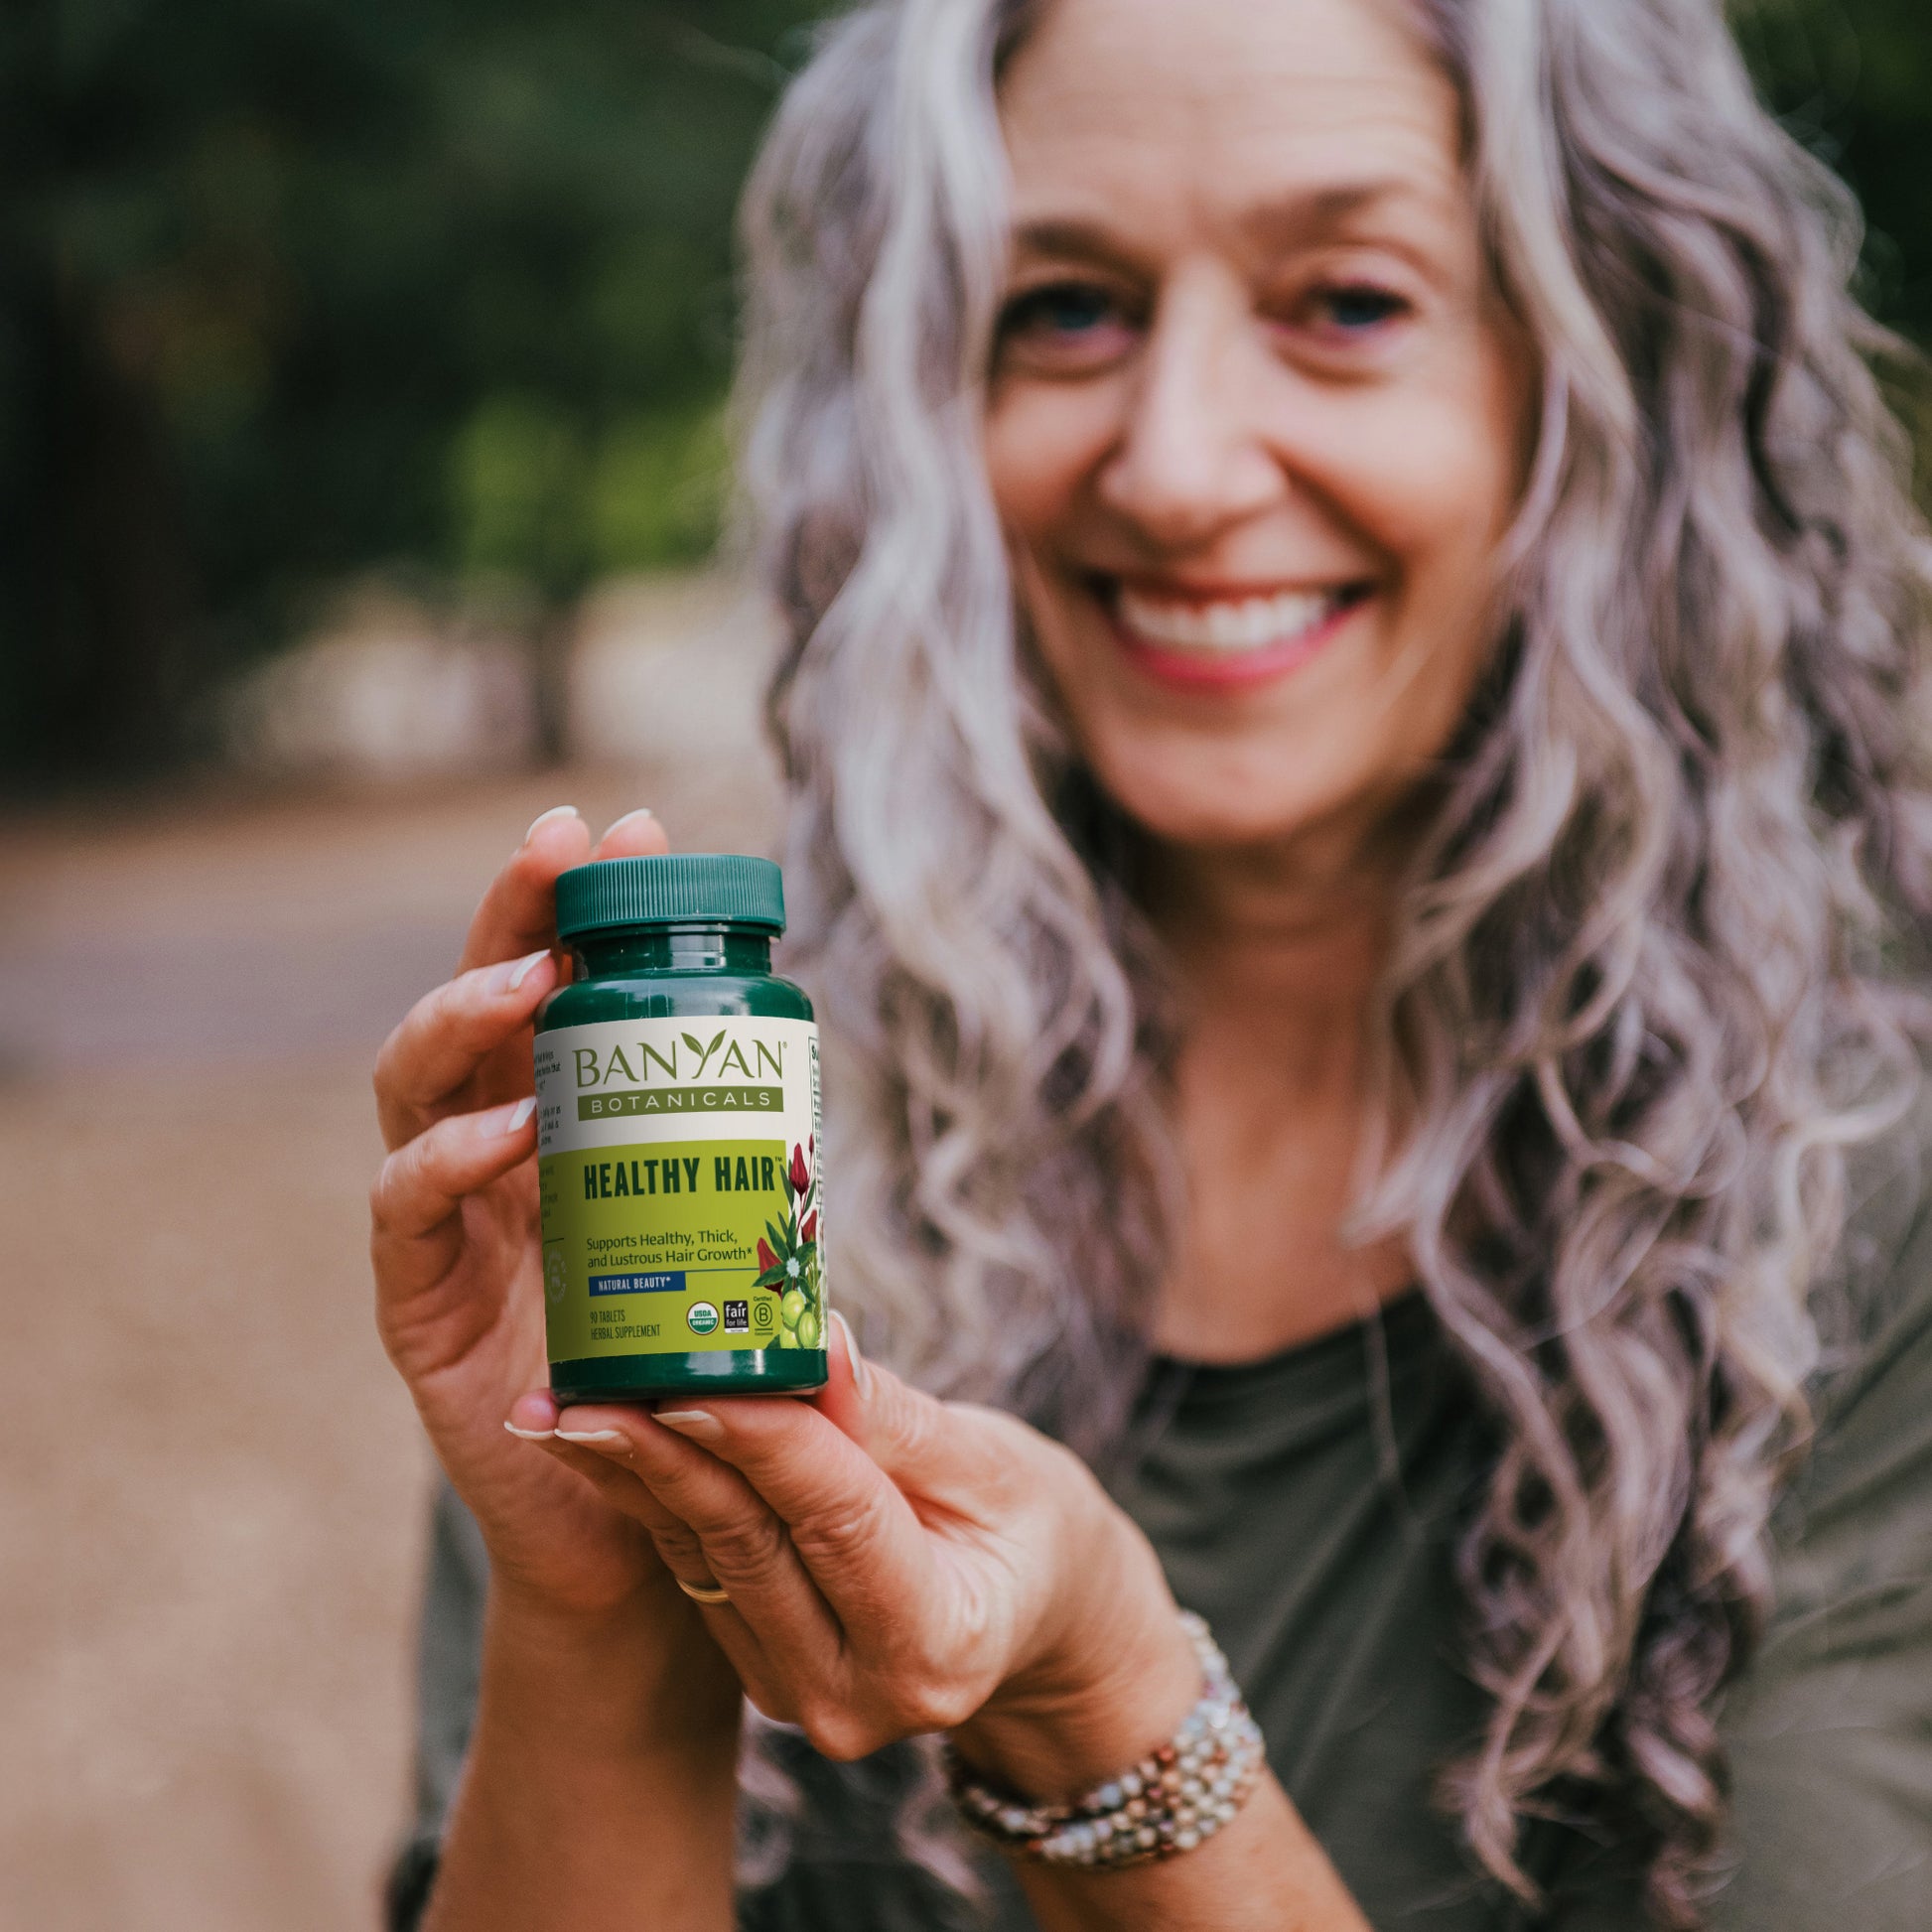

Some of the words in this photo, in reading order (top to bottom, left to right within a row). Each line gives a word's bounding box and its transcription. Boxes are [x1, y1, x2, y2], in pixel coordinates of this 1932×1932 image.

[592, 1092, 770, 1114] BOTANICALS
[584, 1157, 700, 1199] HEALTHY
[587, 1234, 636, 1252] Supports
[640, 1230, 695, 1247] Healthy,
[697, 1229, 738, 1244] Thick,
[588, 1254, 608, 1268] and
[610, 1250, 662, 1267] Lustrous
[666, 1248, 695, 1263] Hair
[598, 1278, 630, 1292] NATURAL
[590, 1311, 599, 1323] 90
[599, 1310, 625, 1323] TABLETS
[726, 1302, 747, 1318] fair
[759, 1307, 768, 1321] B
[591, 1325, 614, 1340] HERBAL
[616, 1323, 661, 1338] SUPPLEMENT
